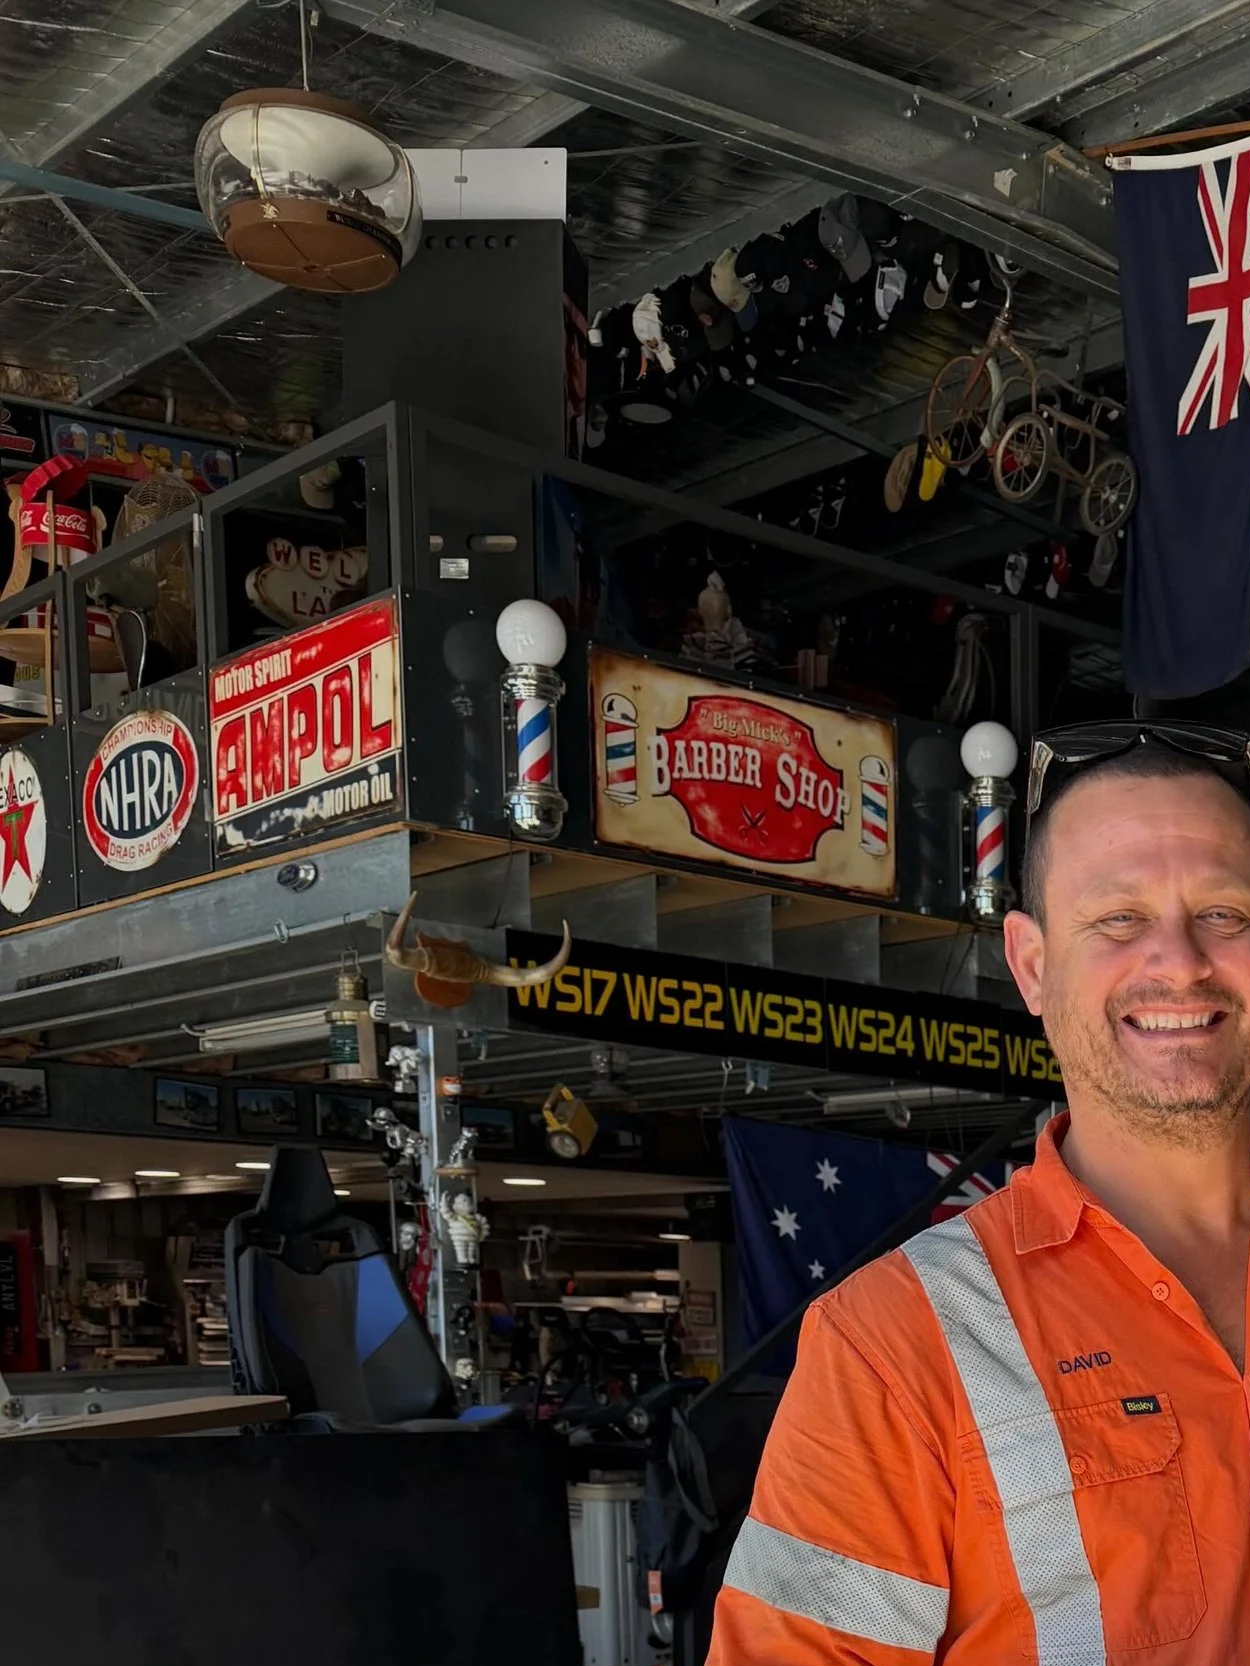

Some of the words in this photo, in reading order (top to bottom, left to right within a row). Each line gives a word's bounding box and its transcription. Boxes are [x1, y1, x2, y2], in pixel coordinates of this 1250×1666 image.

[42, 511, 87, 533] Cca-Cola
[292, 591, 326, 617] LA
[214, 667, 254, 703] MOTOR
[254, 648, 292, 688] SPIRIT
[102, 719, 173, 761] CHAMPIONSHIP
[217, 652, 392, 817] AMPOL
[100, 749, 179, 832] NHRA
[322, 779, 369, 818] MOTOR
[370, 772, 393, 804] OIL
[647, 734, 762, 796] BARBER
[775, 752, 850, 825] SHOP
[109, 841, 136, 859] DRAG
[138, 823, 174, 857] RACING
[509, 957, 617, 1016] WS17
[623, 972, 725, 1031] WS22
[729, 987, 823, 1045] WS23
[828, 1003, 915, 1058] WS24
[919, 1017, 1000, 1070] WS25
[1005, 1033, 1065, 1083] WS2
[1058, 1350, 1112, 1375] DAVID
[1126, 1401, 1154, 1412] Bisley
